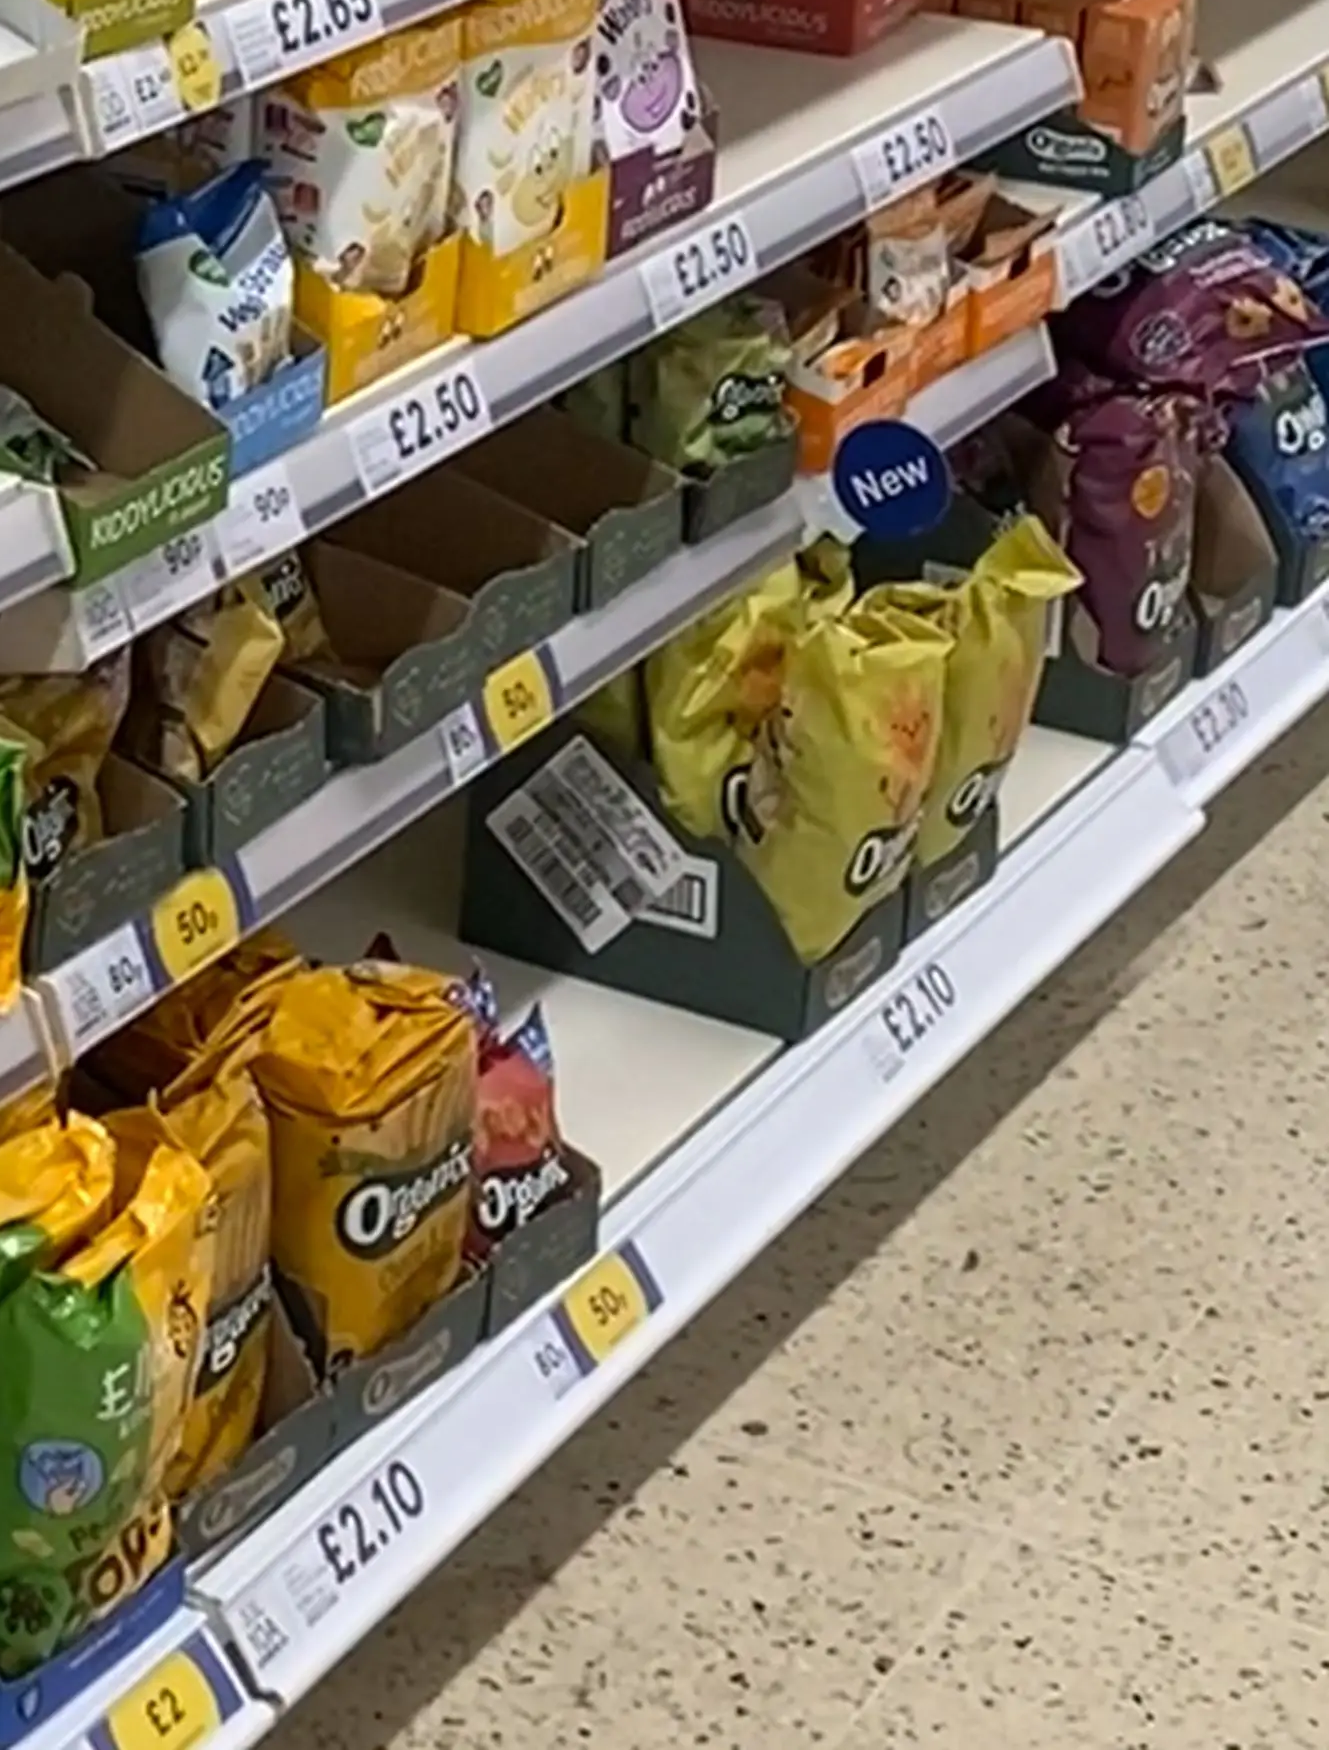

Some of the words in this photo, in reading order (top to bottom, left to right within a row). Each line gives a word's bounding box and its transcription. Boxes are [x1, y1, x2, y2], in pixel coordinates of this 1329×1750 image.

[881, 117, 950, 182] £2.50
[673, 224, 751, 298] £2.50
[388, 374, 482, 457] £2.50
[89, 458, 226, 551] KIDDYLICIOUS
[253, 486, 291, 523] 90p
[850, 457, 931, 509] New
[165, 536, 202, 575] 90p
[500, 679, 539, 719] 50p
[1189, 681, 1252, 754] £2.30
[175, 903, 219, 948] 50p
[881, 963, 959, 1055] £2.10
[342, 1137, 474, 1247] Organix
[590, 1281, 631, 1327] 50p
[316, 1459, 429, 1588] £2.10
[146, 1687, 190, 1737] £2
